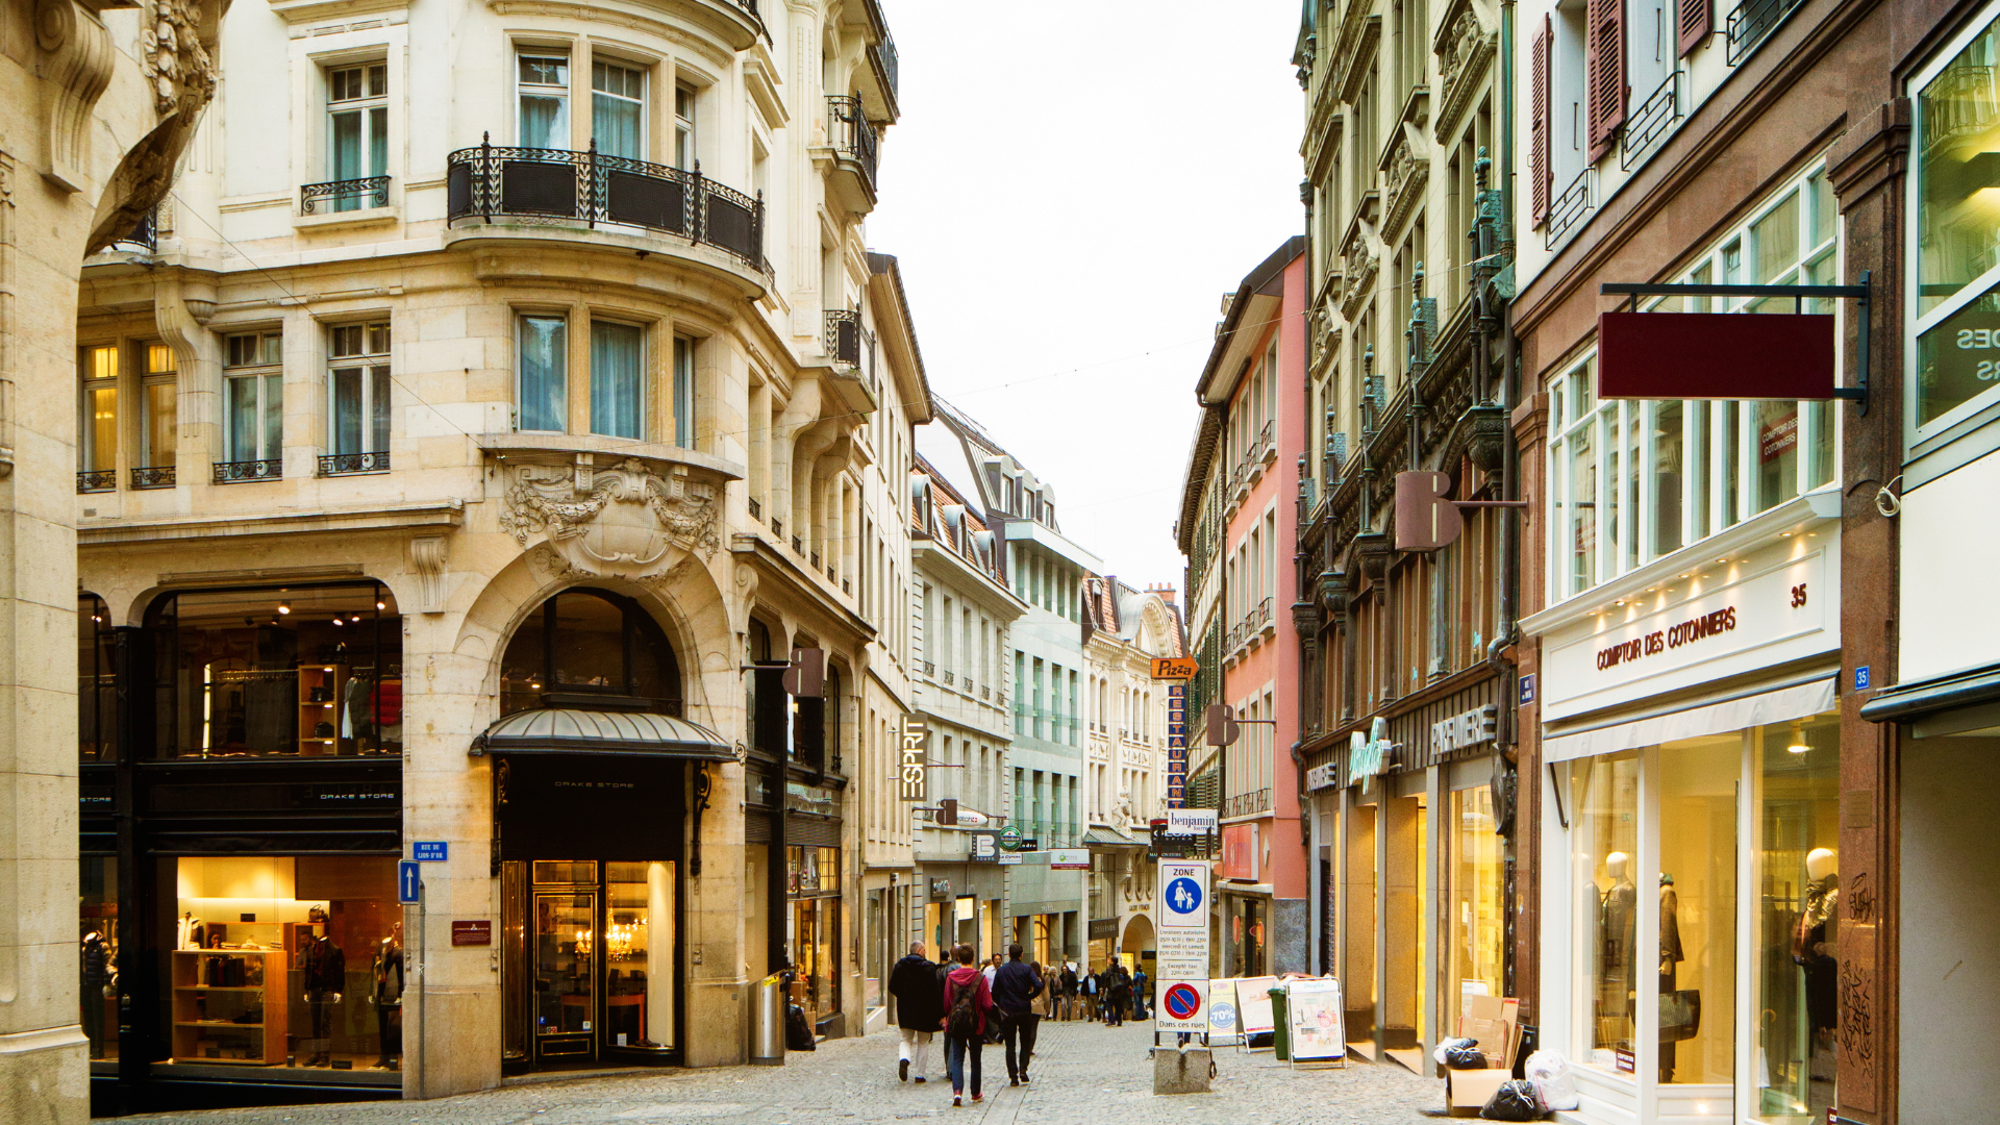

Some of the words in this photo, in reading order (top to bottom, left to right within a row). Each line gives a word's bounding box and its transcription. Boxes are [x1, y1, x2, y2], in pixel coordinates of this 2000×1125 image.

[1762, 423, 1787, 443] COMPTOIR
[1791, 583, 1807, 608] 35
[1597, 638, 1642, 671] COMPTOIR
[1645, 630, 1664, 656] DES
[1668, 606, 1735, 649] COTONNIERS
[1157, 660, 1192, 676] Pizza
[1857, 671, 1867, 685] 35
[1431, 704, 1496, 755] PARFUMERIE
[903, 716, 924, 798] ESPRIT
[1172, 686, 1182, 808] RESTAURANT
[1171, 812, 1215, 828] benjamin
[1173, 868, 1195, 876] ZONE
